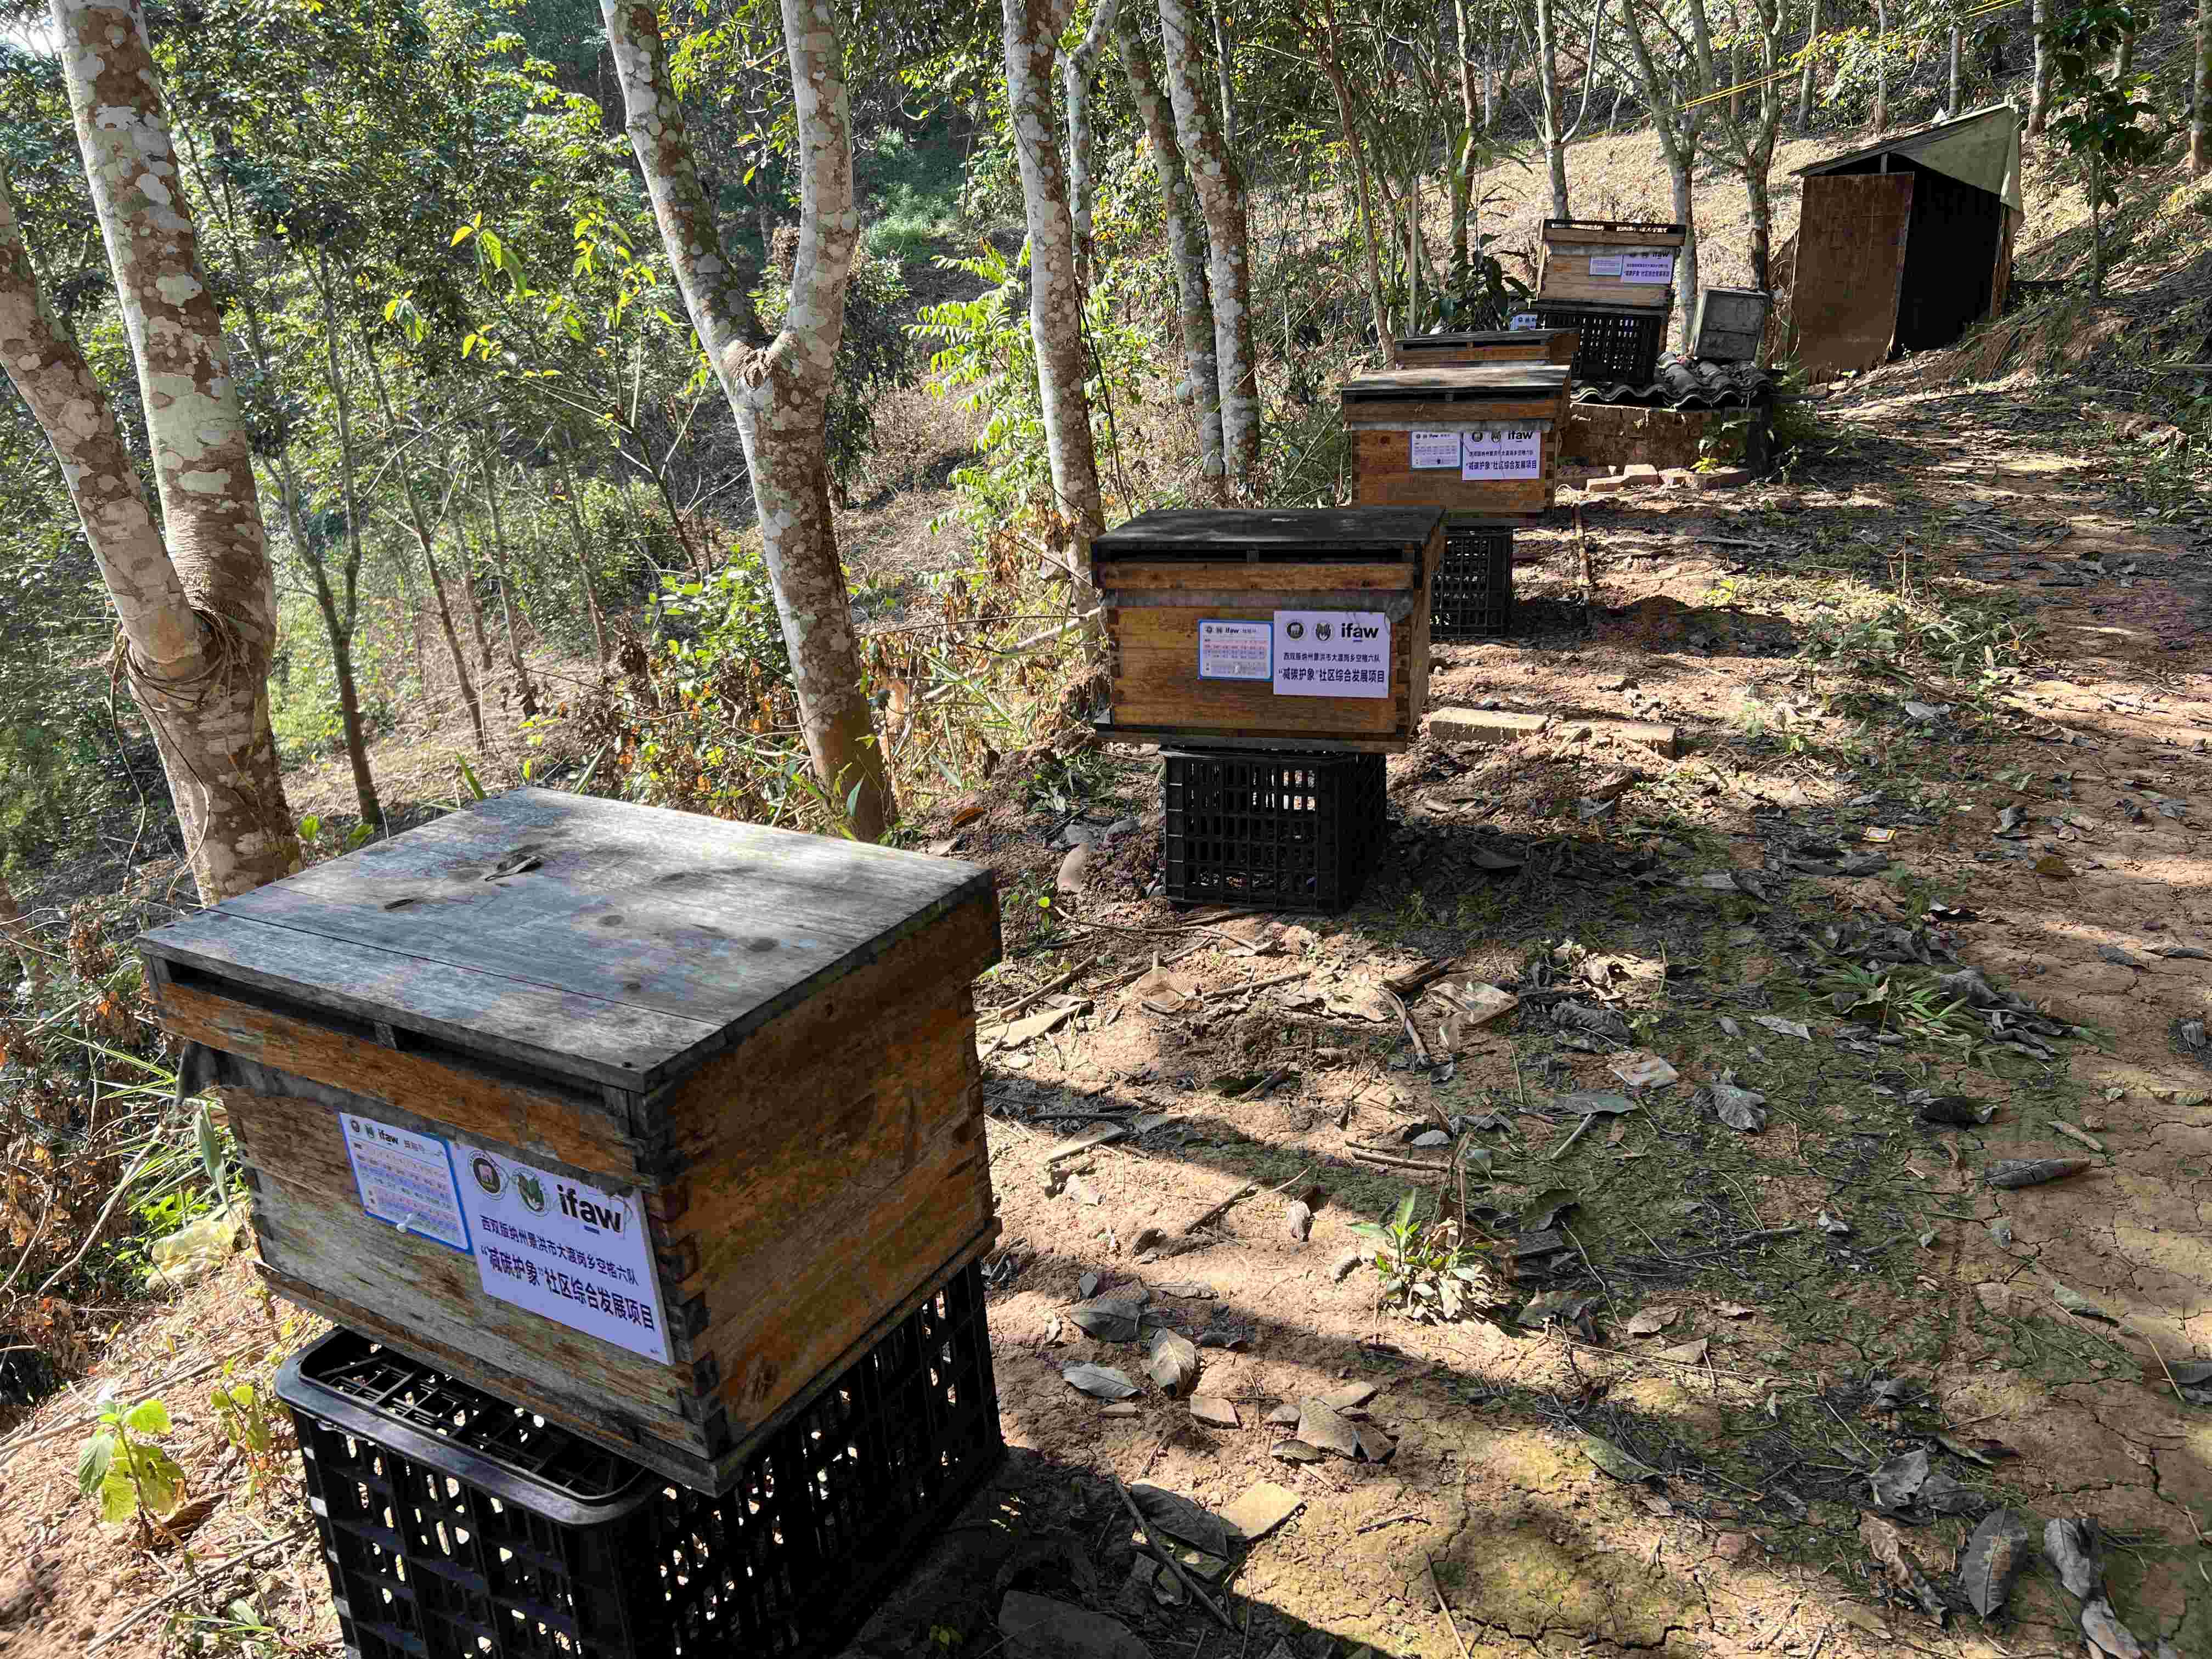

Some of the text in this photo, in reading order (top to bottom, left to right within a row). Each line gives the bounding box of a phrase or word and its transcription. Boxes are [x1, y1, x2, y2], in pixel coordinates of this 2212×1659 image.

[1341, 623, 1379, 638] ifaw
[377, 1128, 399, 1145] ifaw
[557, 1184, 621, 1233] ifaw
